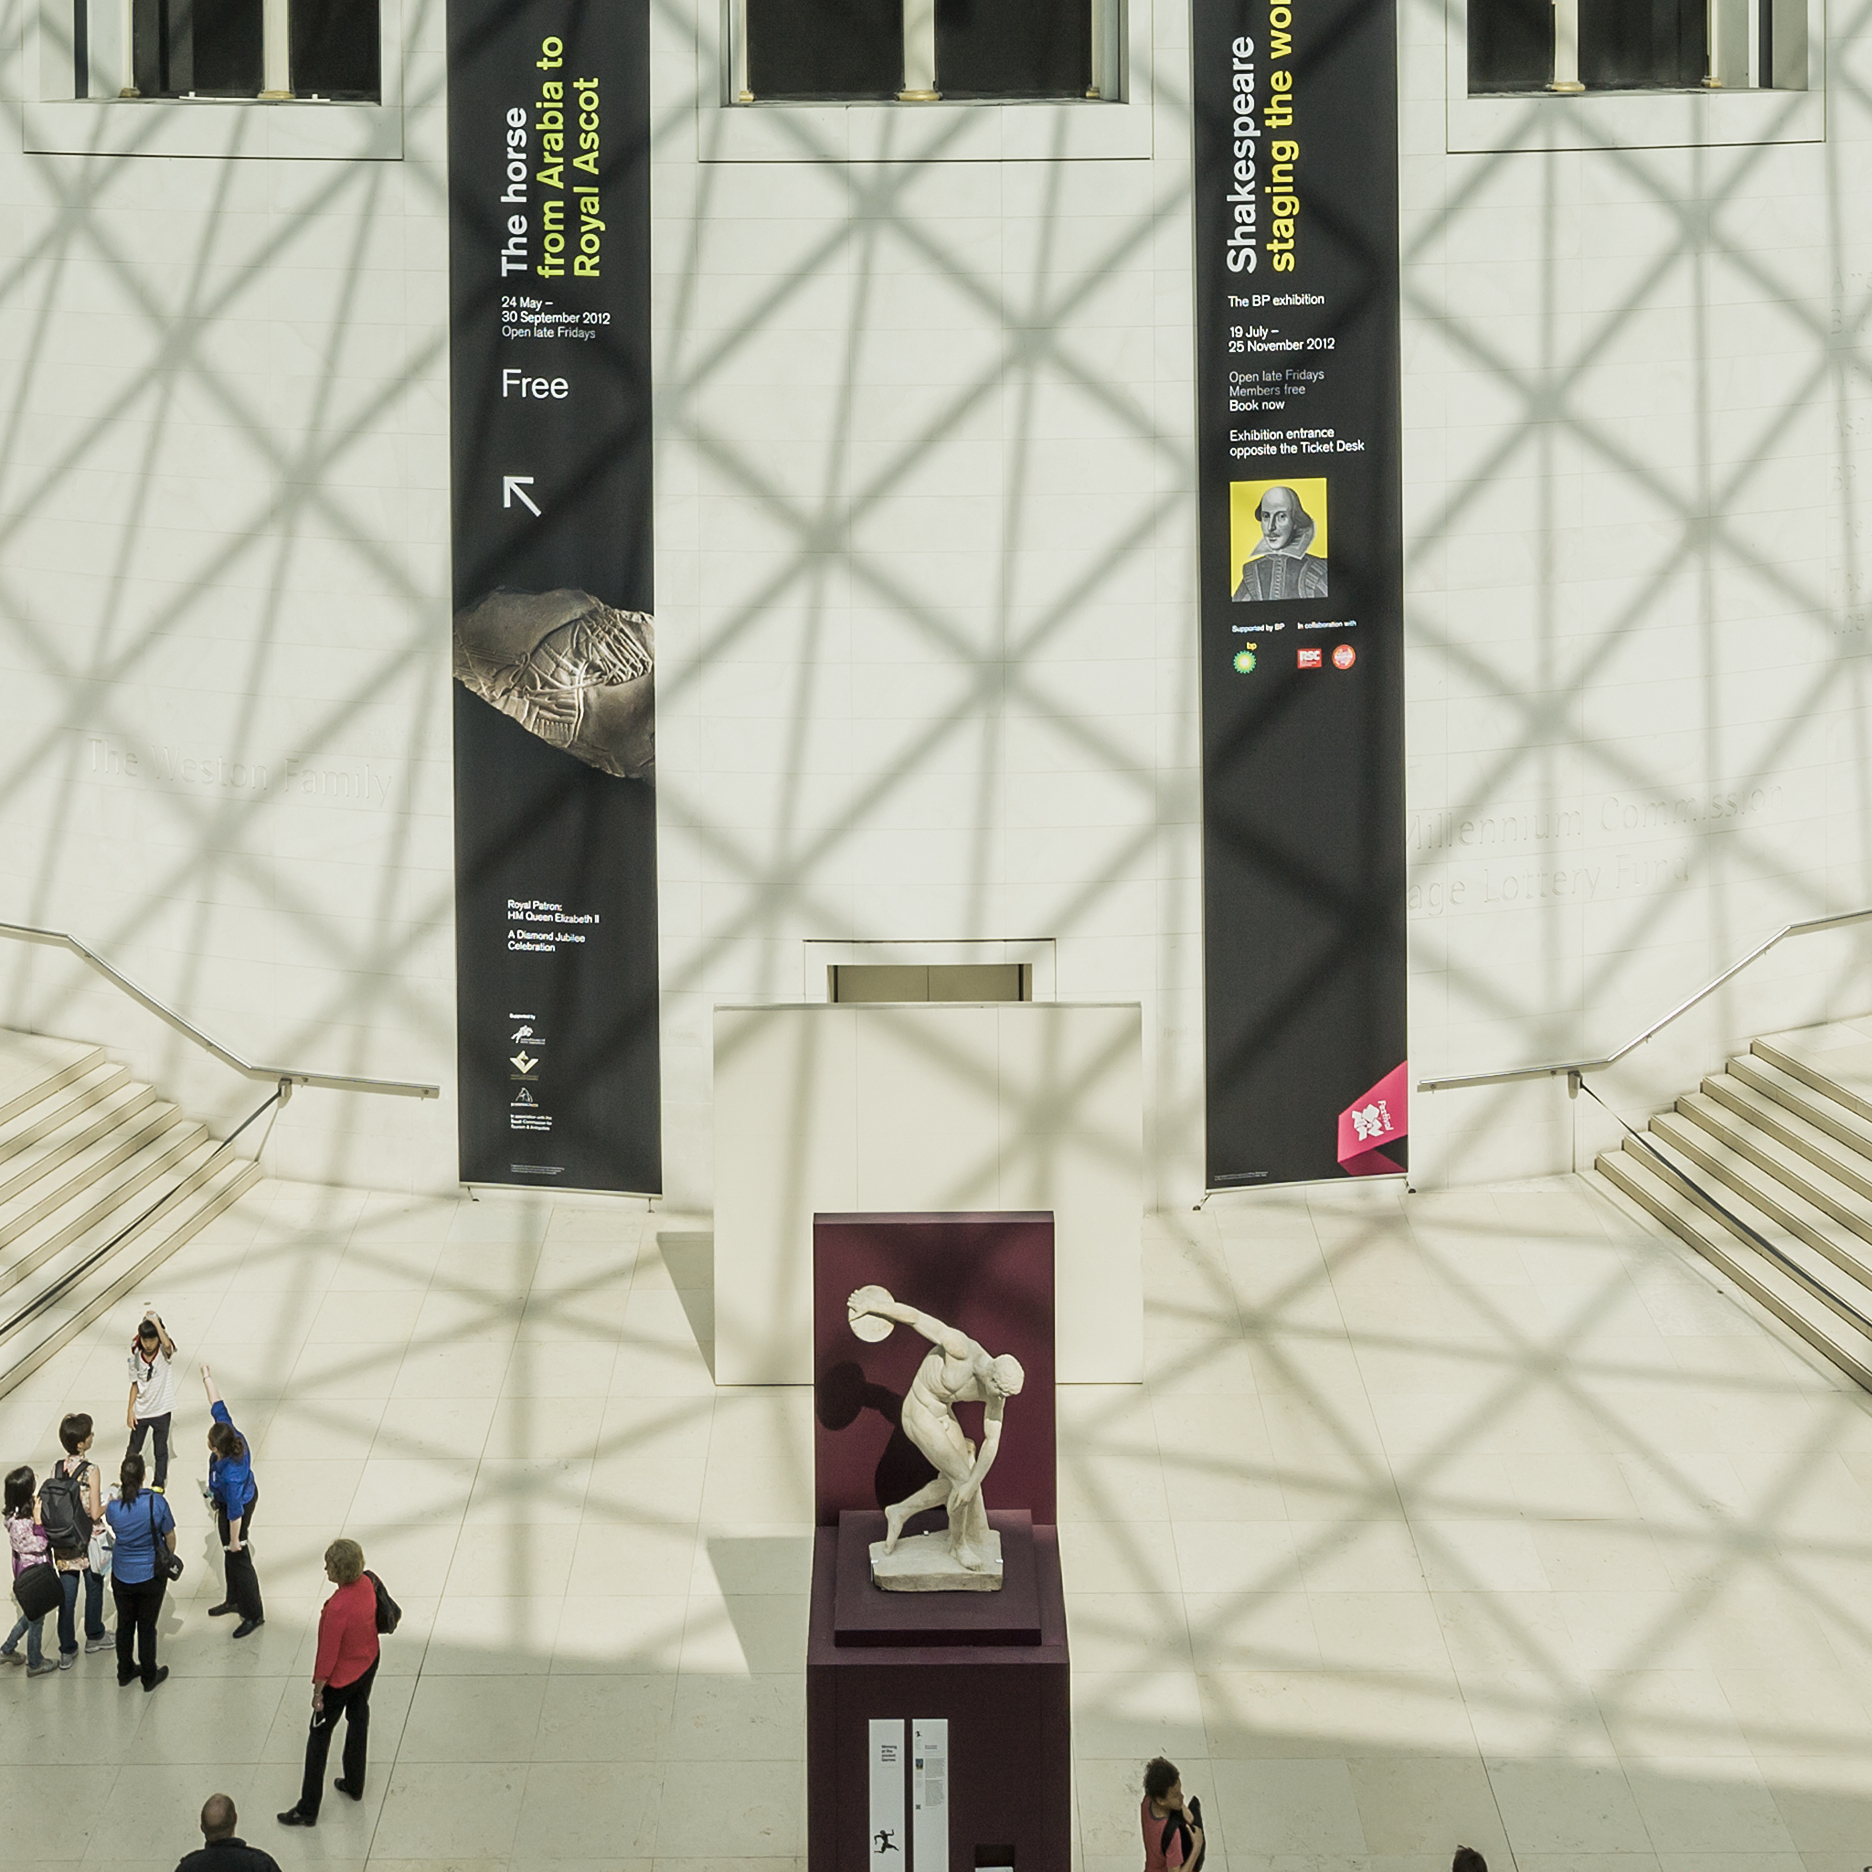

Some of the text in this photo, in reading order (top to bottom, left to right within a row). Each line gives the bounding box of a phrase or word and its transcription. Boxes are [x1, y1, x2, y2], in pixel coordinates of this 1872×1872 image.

[1264, 70, 1293, 129] the
[536, 36, 565, 278] from Arabia to
[1227, 37, 1261, 273] Shakespeare
[573, 77, 606, 277] Royal Ascot
[501, 107, 528, 277] The horse
[1265, 140, 1300, 272] staging
[501, 295, 517, 308] 24
[519, 296, 543, 311] May
[1228, 293, 1325, 307] The BP exhibition
[501, 310, 611, 326] 30 September 2012
[501, 325, 596, 341] Open late Fridays
[1229, 325, 1243, 338] 19
[1245, 325, 1268, 340] July
[1228, 337, 1336, 353] 25 November 2012
[502, 368, 569, 399] Free
[1229, 369, 1325, 385] Open late Fridays
[1229, 383, 1306, 397] Members free
[1229, 399, 1285, 412] Book now
[1229, 427, 1335, 442] Exhibition entrance
[1229, 439, 1365, 459] opposite the Ticket Desk
[507, 899, 531, 911] Royal
[507, 911, 524, 920] HM
[525, 911, 554, 922] Queen
[554, 913, 593, 924] Elizabeth
[507, 929, 516, 939] A
[507, 940, 556, 953] Celebration
